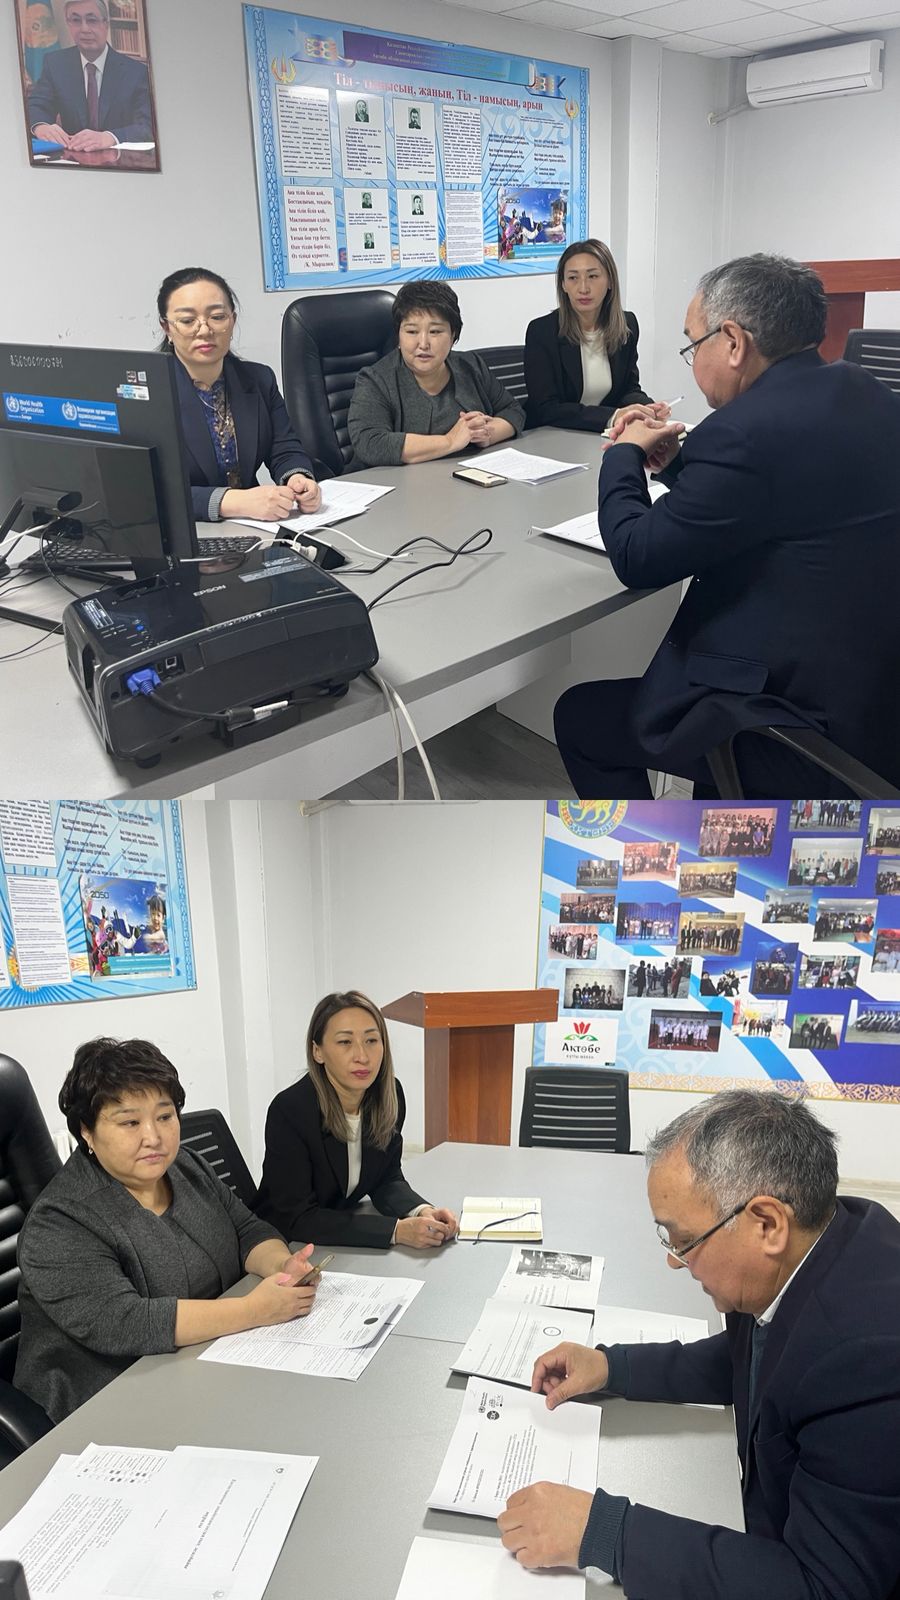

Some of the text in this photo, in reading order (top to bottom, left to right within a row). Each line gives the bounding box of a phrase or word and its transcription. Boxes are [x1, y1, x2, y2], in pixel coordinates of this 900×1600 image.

[456, 89, 472, 101] Тіл
[193, 584, 227, 597] EPSON
[90, 890, 110, 899] 2050
